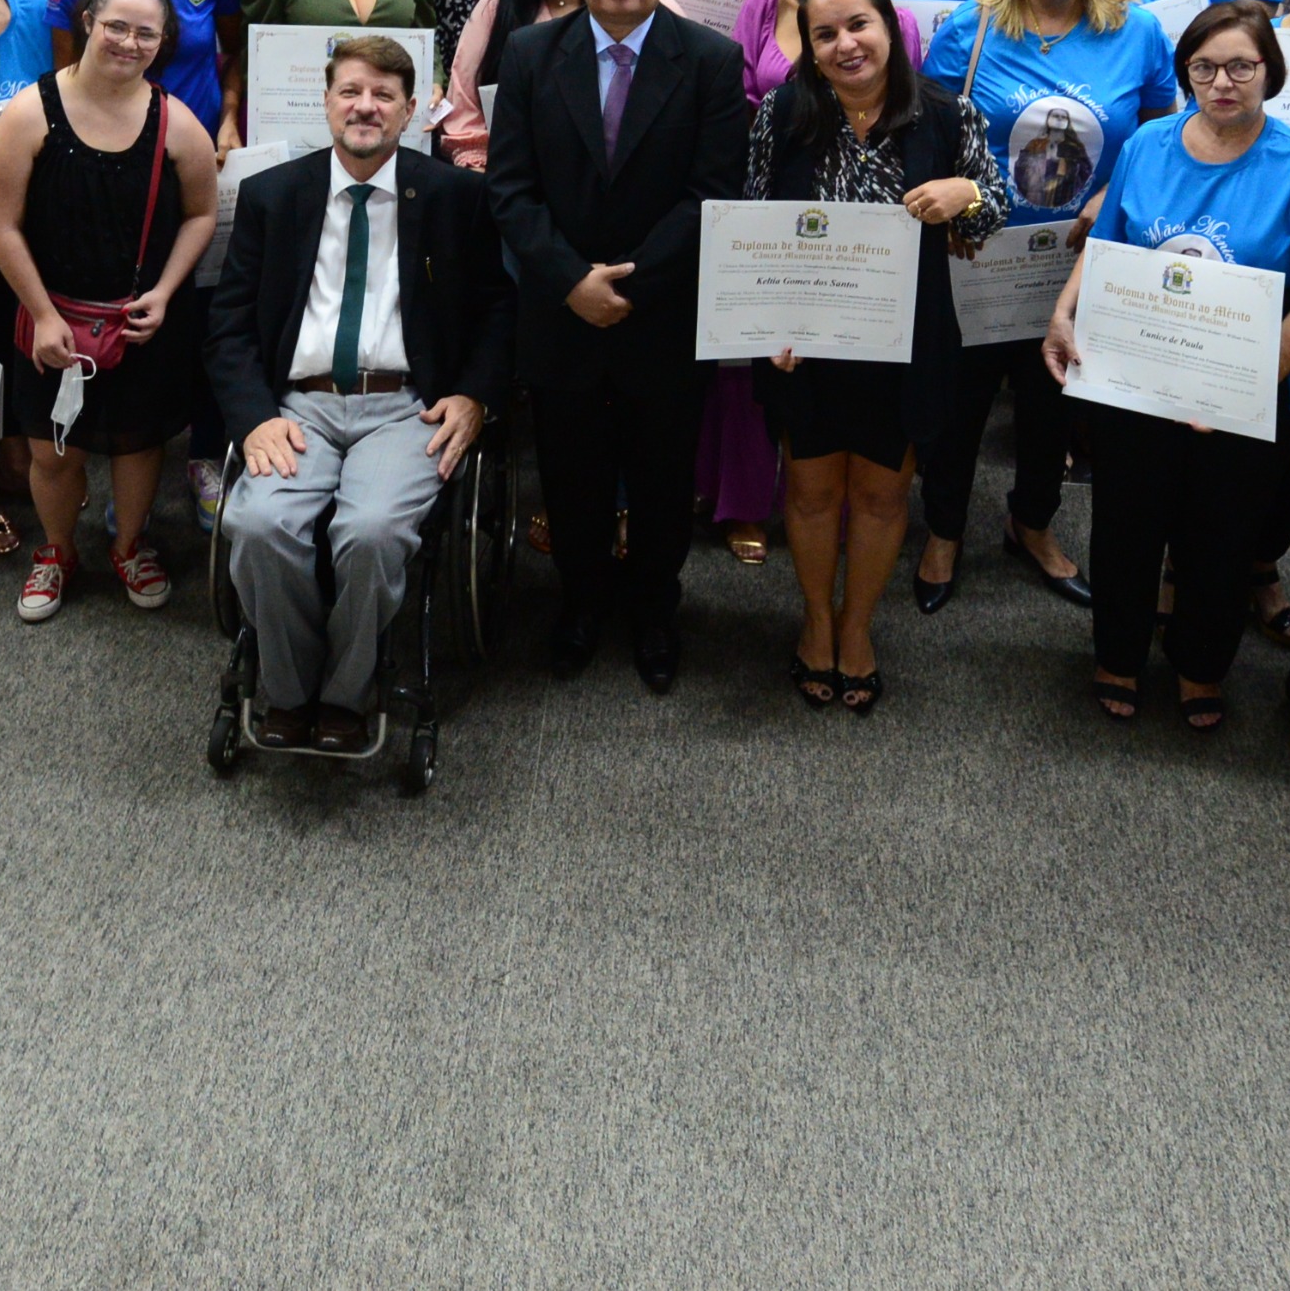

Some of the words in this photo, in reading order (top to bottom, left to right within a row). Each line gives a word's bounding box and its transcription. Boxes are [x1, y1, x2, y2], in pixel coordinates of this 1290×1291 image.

[1005, 84, 1049, 114] Mães
[1141, 216, 1186, 249] Mães
[731, 240, 778, 252] Diploma
[781, 241, 793, 251] de
[797, 240, 833, 253] Honra
[852, 243, 891, 256] Mérito
[971, 259, 1013, 269] Diploma
[756, 277, 781, 286] Keltia
[783, 277, 811, 286] Gomes
[813, 278, 828, 287] dos
[829, 279, 859, 289] Santos
[1104, 281, 1146, 300] Diploma
[1148, 292, 1159, 303] de
[1161, 294, 1195, 312] Honra
[1197, 303, 1210, 314] ao
[1213, 305, 1252, 323] Mérito
[1140, 328, 1168, 343] Eunice
[1168, 335, 1179, 345] de
[1179, 337, 1204, 351] Paula
